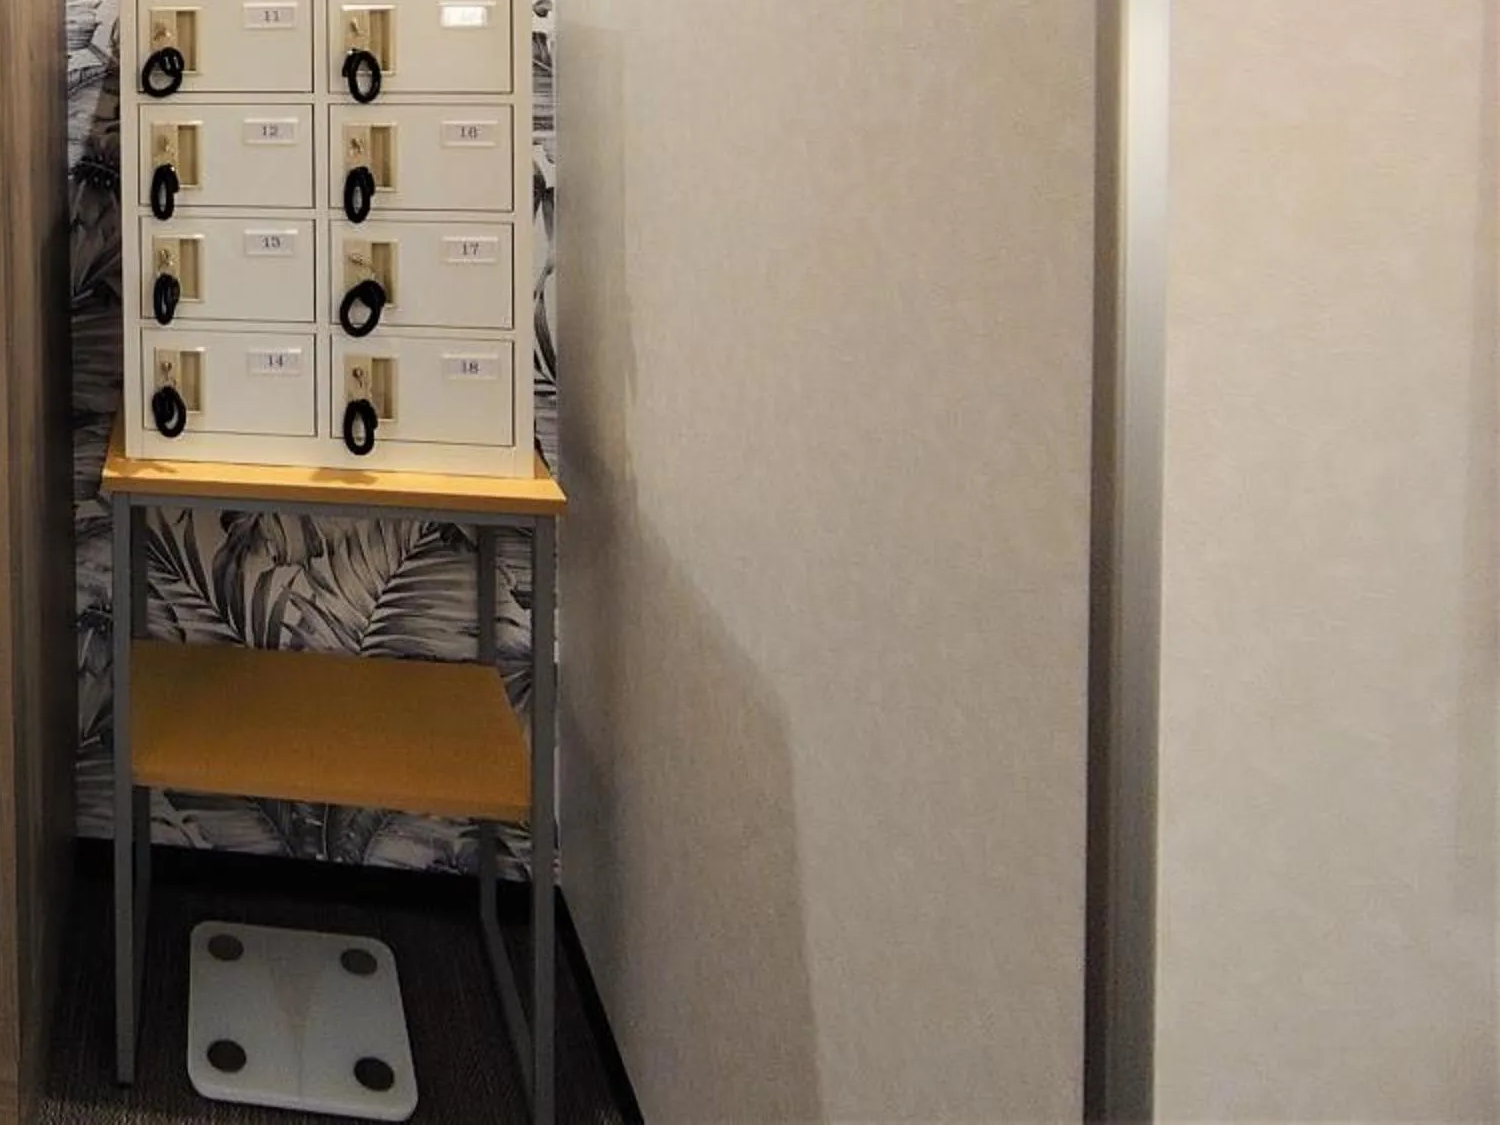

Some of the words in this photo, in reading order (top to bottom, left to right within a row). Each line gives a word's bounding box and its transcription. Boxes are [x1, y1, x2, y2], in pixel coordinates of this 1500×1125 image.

[263, 10, 280, 23] 11
[262, 125, 279, 137] 12
[462, 242, 479, 256] 17
[268, 354, 284, 367] 14
[461, 360, 479, 375] 18
